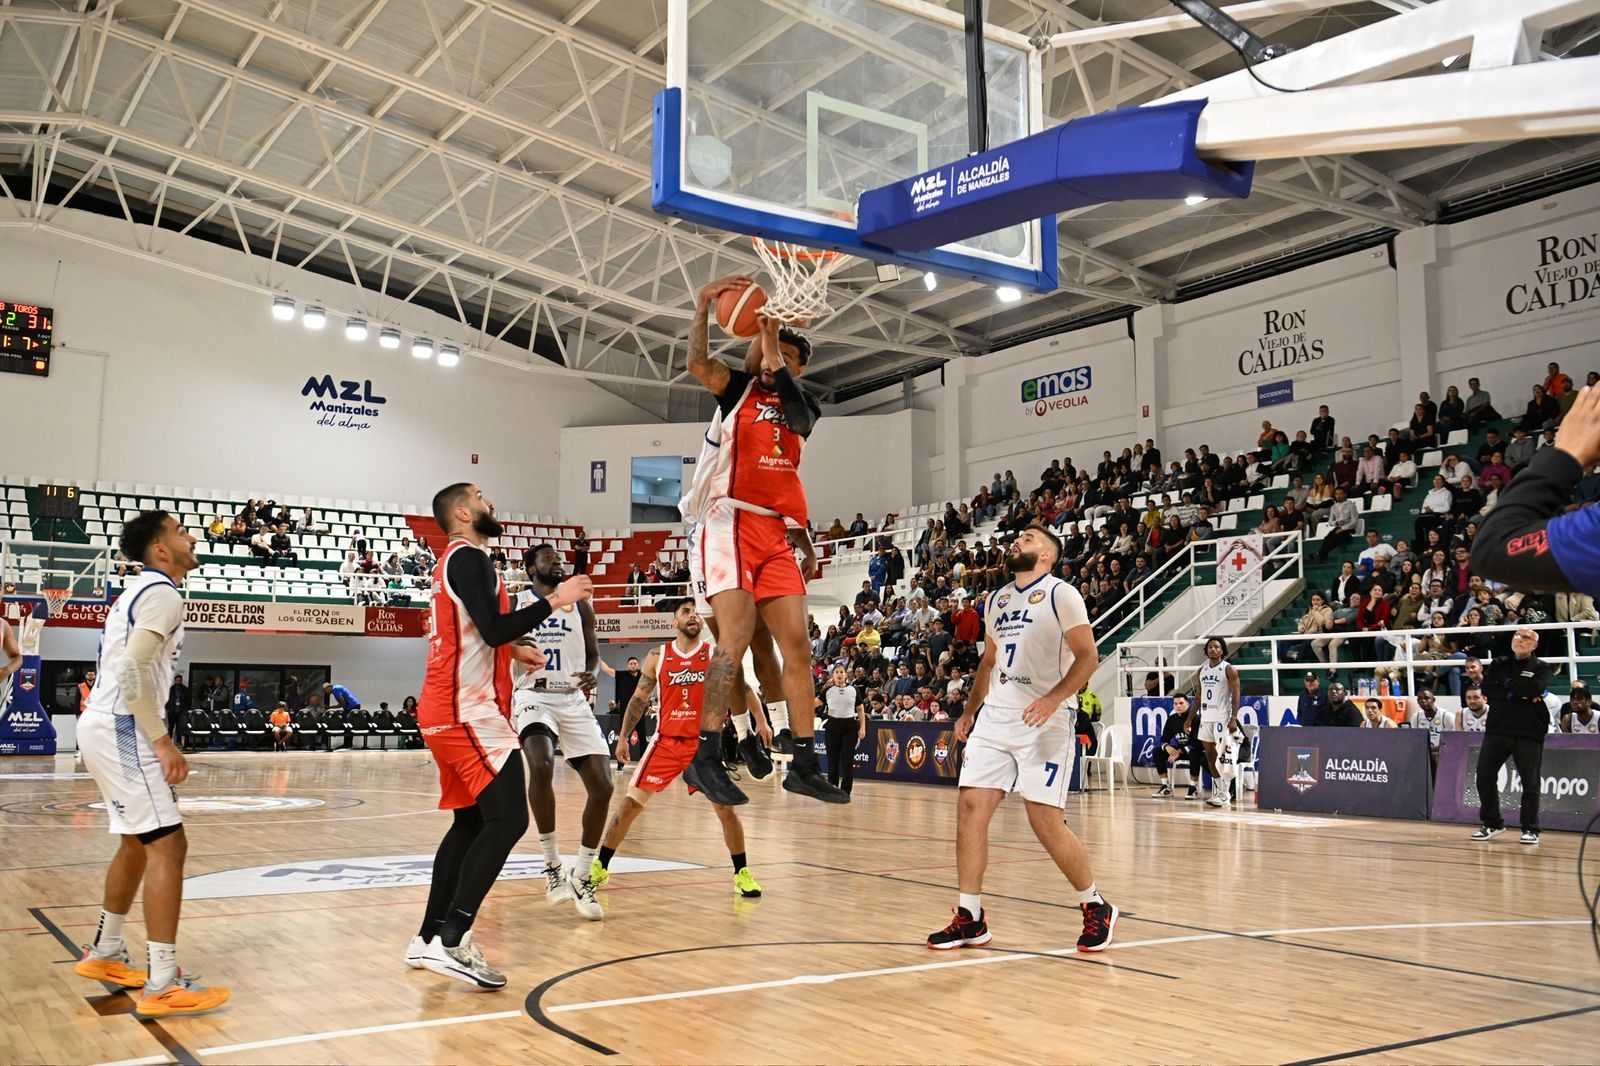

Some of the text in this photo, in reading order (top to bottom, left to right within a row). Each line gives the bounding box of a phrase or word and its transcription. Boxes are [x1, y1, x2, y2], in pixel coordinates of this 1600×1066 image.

[958, 156, 1010, 184] ALCALDÍA
[911, 171, 947, 197] MZL
[957, 171, 1010, 195] DE MANIZALES
[1533, 265, 1568, 284] VIEJO
[13, 303, 39, 315] TOROS
[6, 311, 16, 327] 2
[1263, 309, 1306, 336] RON
[1259, 332, 1306, 350] VIEJO DE
[1238, 339, 1324, 376] CALDAS
[301, 374, 387, 404] MZL
[1023, 368, 1090, 401] emas
[1259, 389, 1291, 399] OCCIDENTAL
[309, 400, 379, 417] Manizales
[1048, 396, 1089, 411] VEOLIA
[316, 413, 371, 431] del alma
[773, 428, 781, 442] 3
[758, 455, 791, 467] Algrec
[67, 487, 75, 498] 6
[1222, 596, 1235, 606] 132
[212, 603, 226, 613] ES
[228, 604, 242, 613] EL
[243, 604, 265, 615] RON
[304, 609, 329, 617] RON
[200, 613, 215, 623] DE
[218, 614, 265, 625] CALDAS
[315, 617, 354, 626] SABEN
[367, 620, 403, 632] CALDAS
[994, 609, 1033, 629] MZL
[996, 623, 1025, 632] Manizales
[543, 648, 561, 671] 21
[1005, 643, 1017, 668] 7
[668, 667, 705, 686] TOROS
[682, 688, 689, 700] 9
[1206, 689, 1212, 700] 0
[8, 711, 43, 722] MZL
[671, 710, 697, 718] Algreco
[1216, 722, 1223, 733] 0
[1325, 757, 1388, 773] ALCALDÍA
[1044, 761, 1059, 787] 7
[1325, 771, 1389, 783] DE MANIZALES
